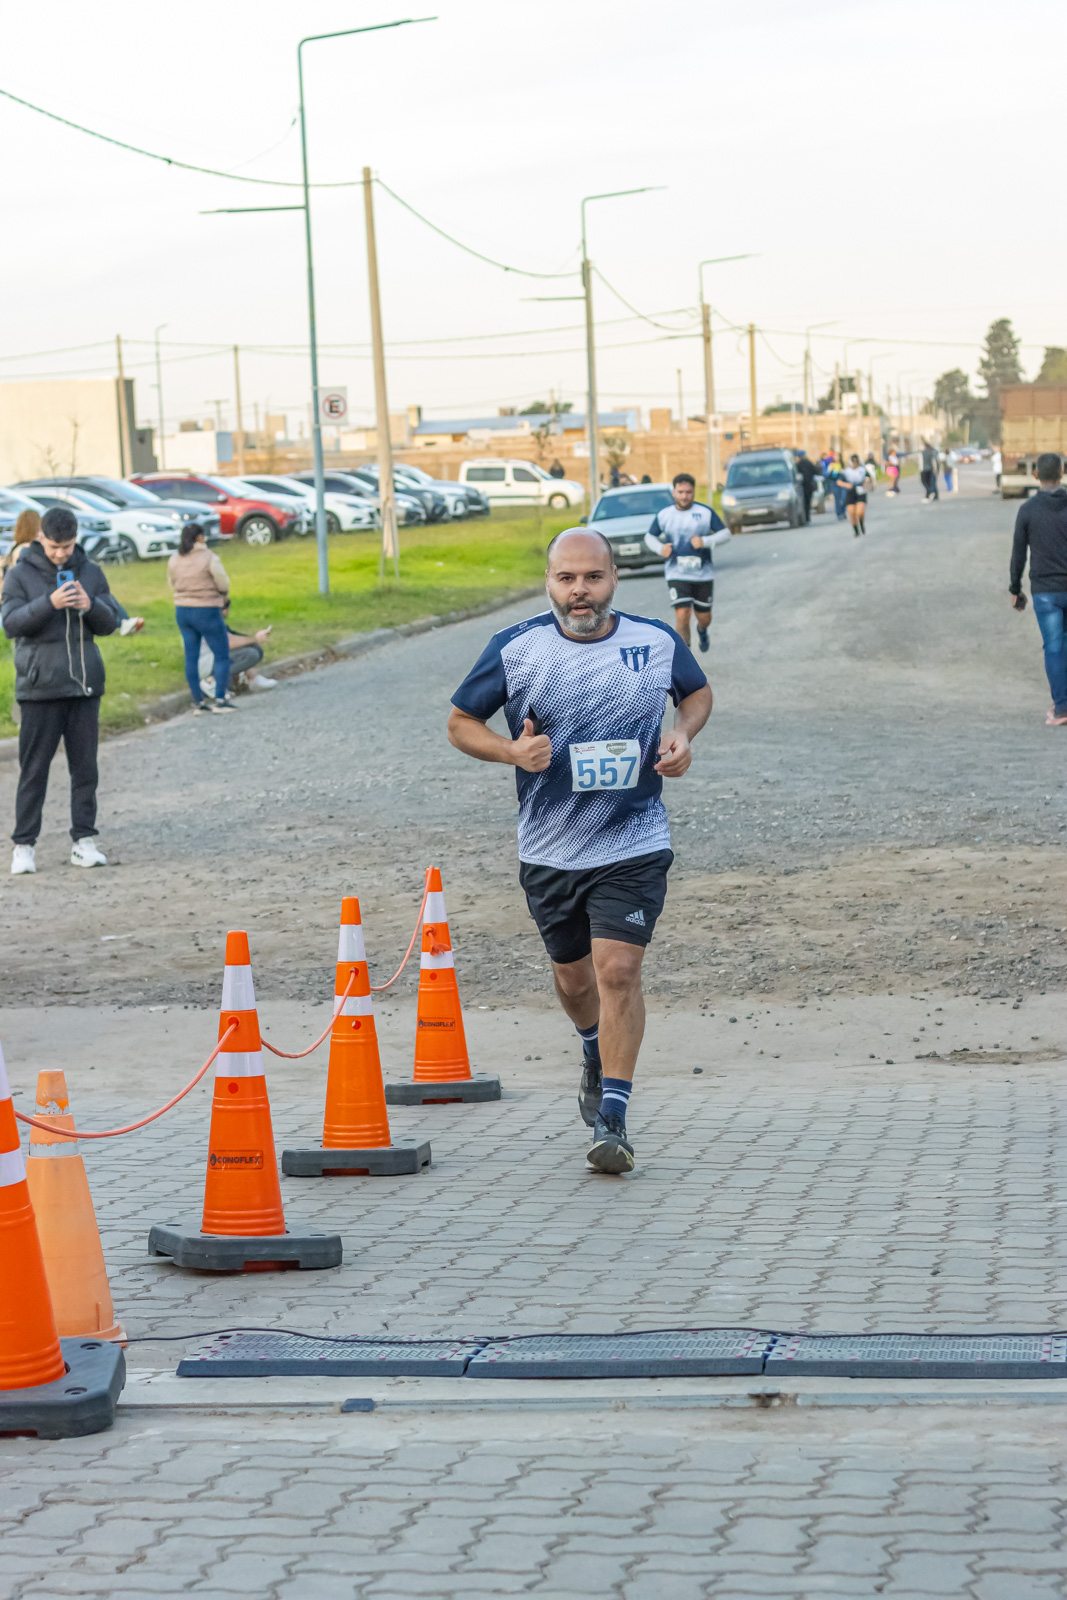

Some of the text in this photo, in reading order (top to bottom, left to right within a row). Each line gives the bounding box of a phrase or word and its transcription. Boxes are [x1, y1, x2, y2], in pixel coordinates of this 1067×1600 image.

[576, 756, 637, 789] 557
[625, 915, 646, 927] adidas
[216, 1156, 260, 1164] CONOFLEX
